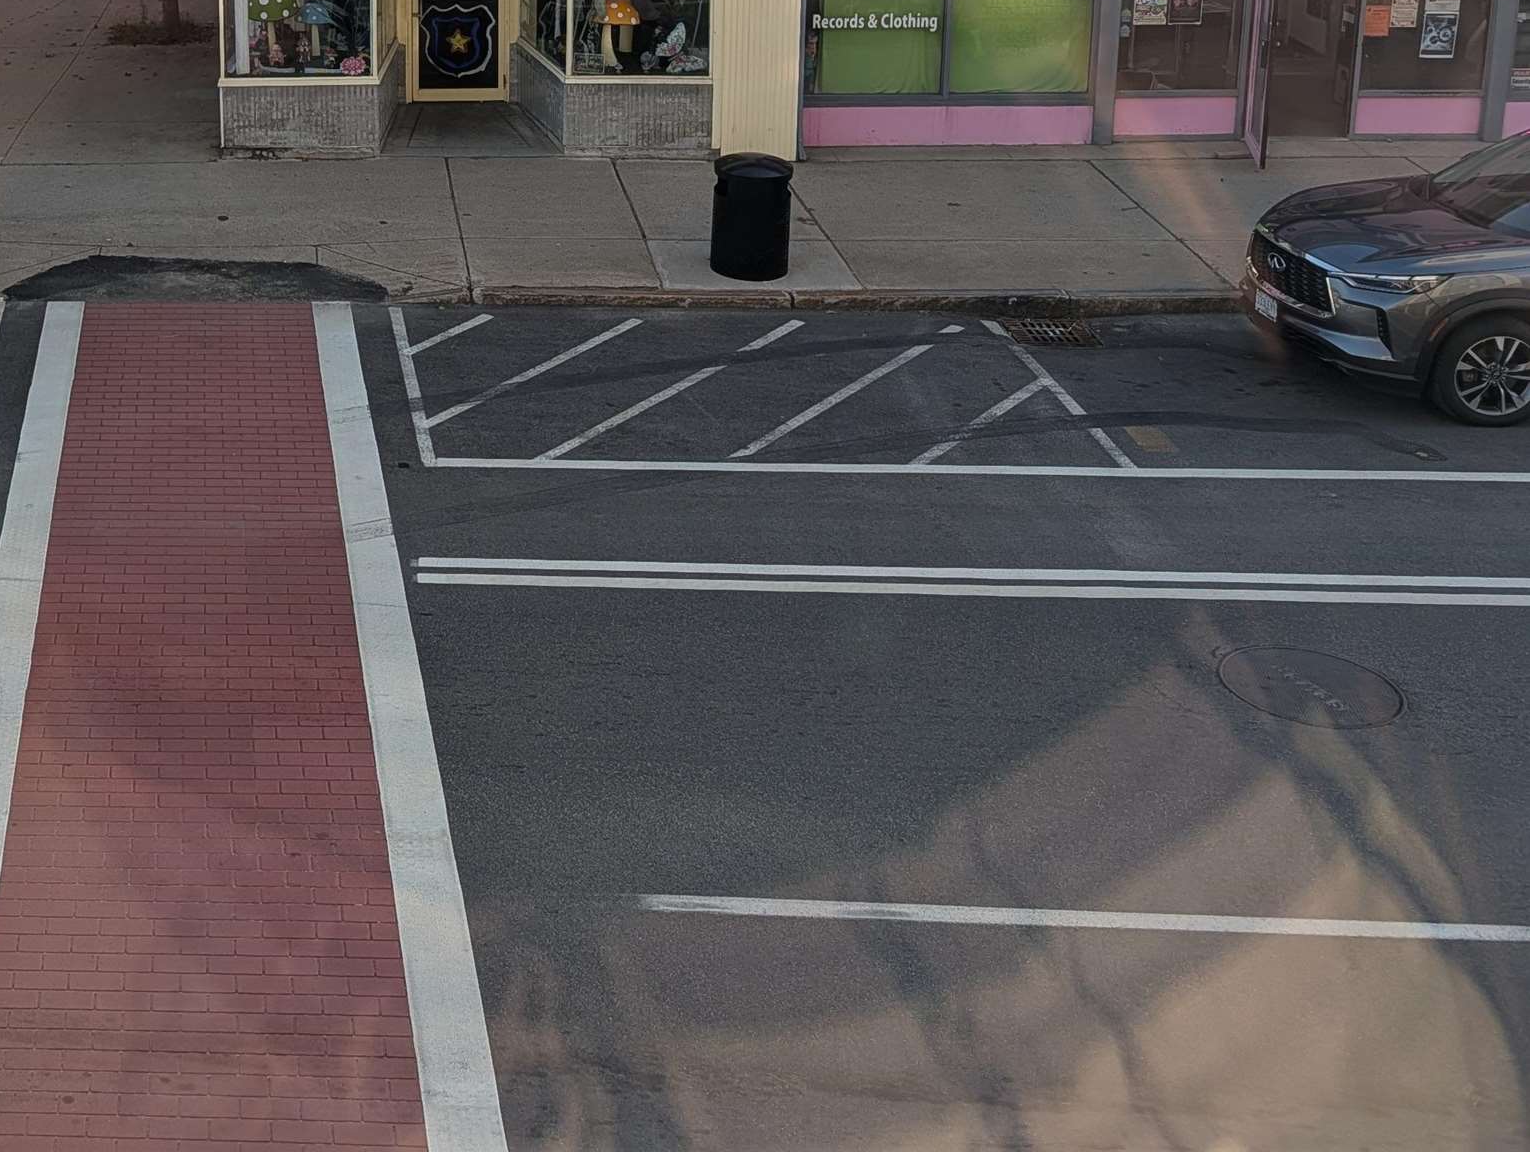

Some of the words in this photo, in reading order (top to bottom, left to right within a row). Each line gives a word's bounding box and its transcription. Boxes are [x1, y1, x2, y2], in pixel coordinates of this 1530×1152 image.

[811, 13, 865, 29] Records
[867, 13, 878, 29] &
[880, 13, 938, 32] Clothing
